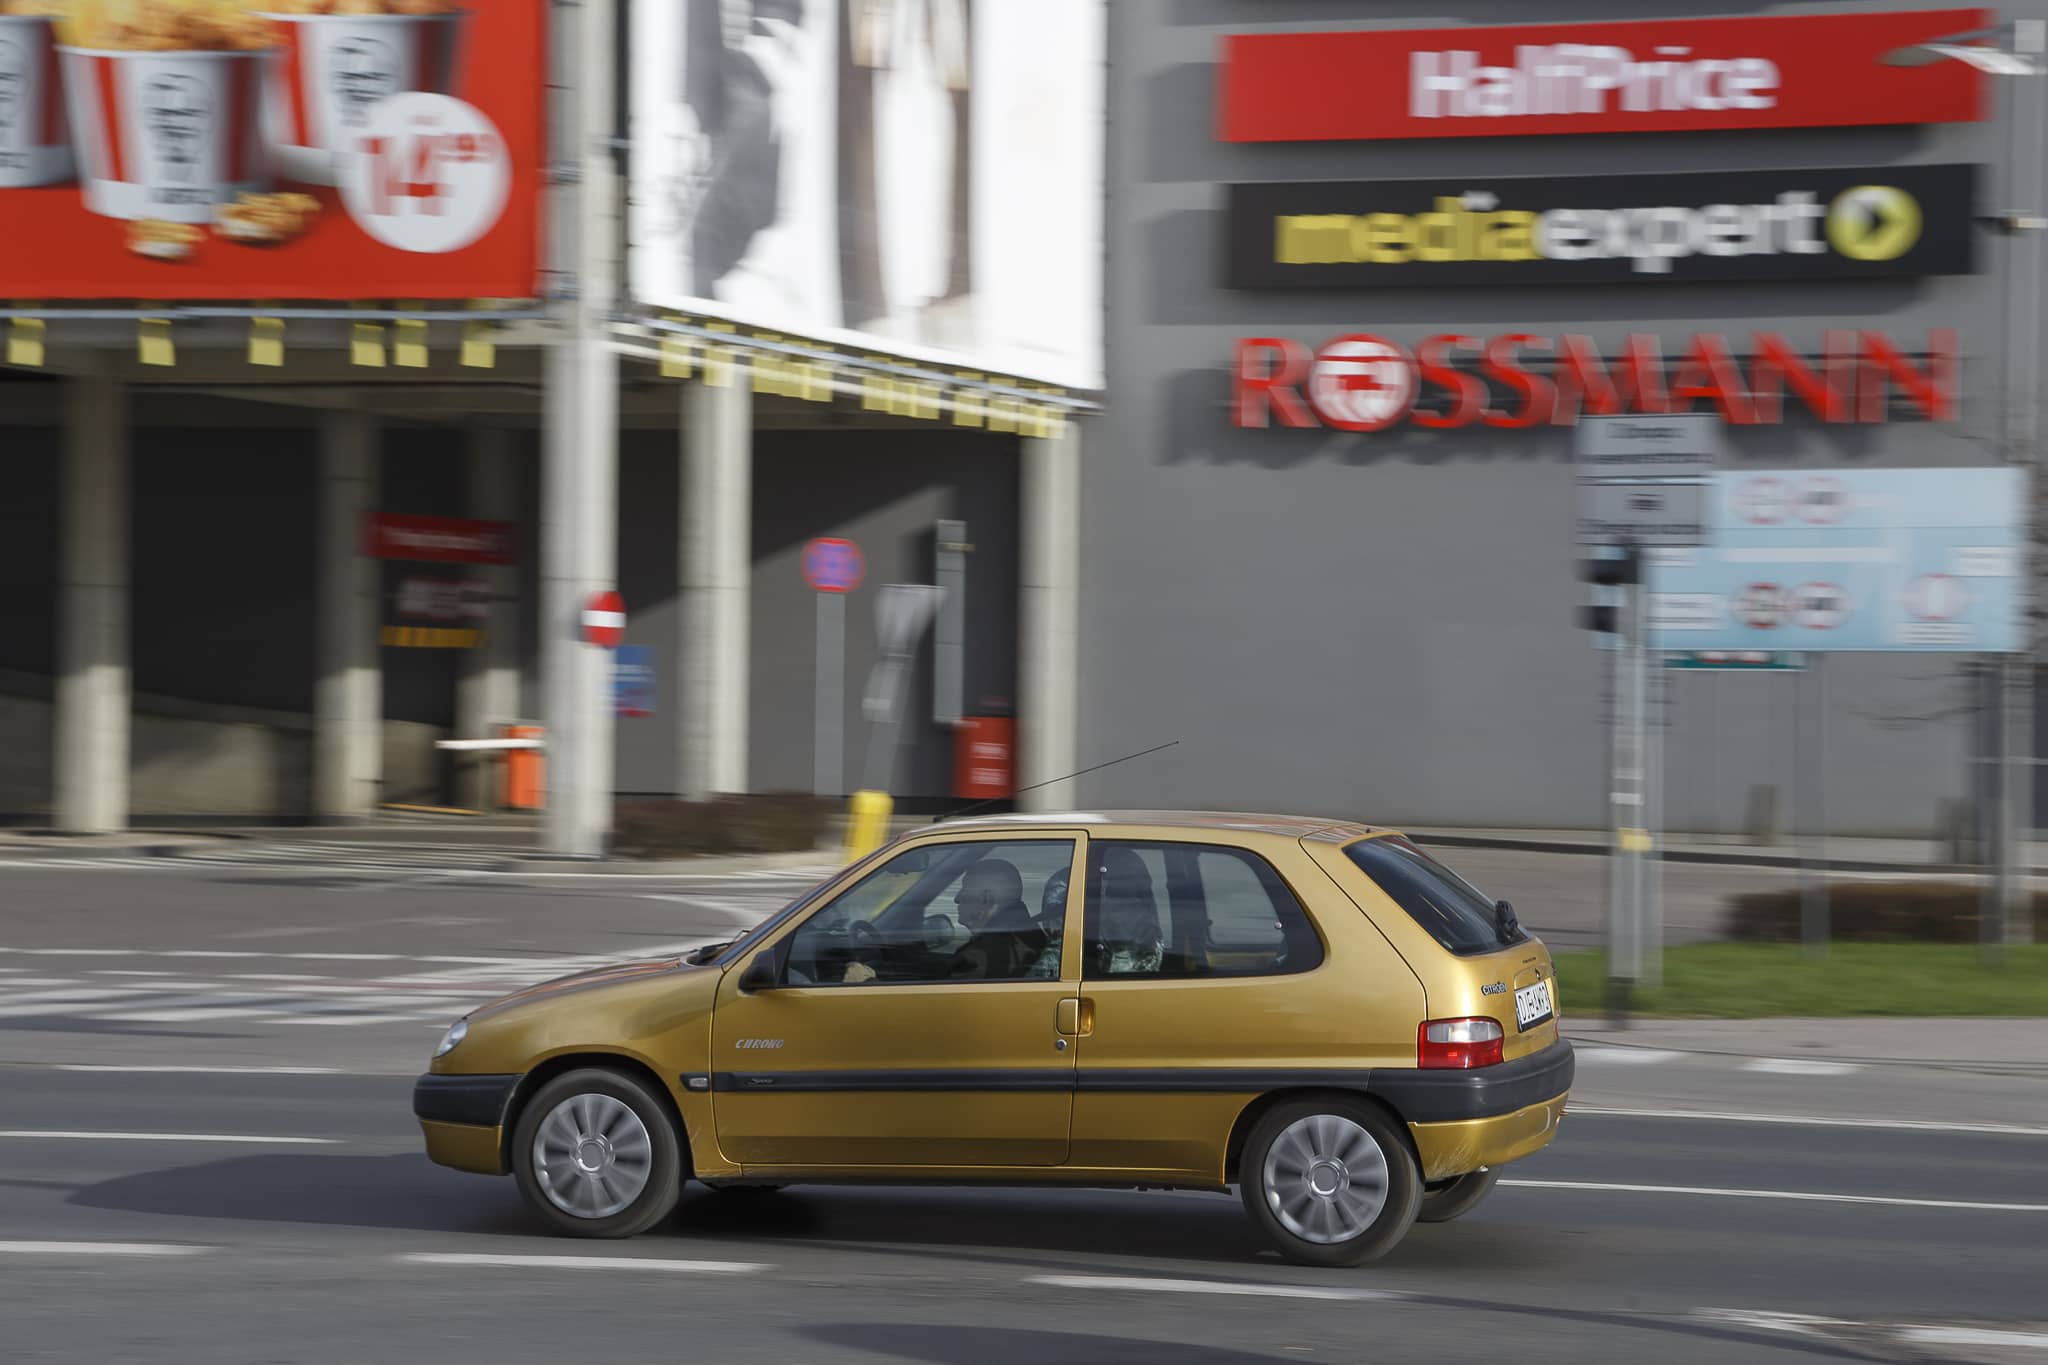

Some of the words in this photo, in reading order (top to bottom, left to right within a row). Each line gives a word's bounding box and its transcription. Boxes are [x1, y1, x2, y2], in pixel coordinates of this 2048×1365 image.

[1409, 43, 1780, 118] HalfPrice
[1233, 328, 1957, 432] ROSSMANN
[735, 1039, 785, 1049] CHRONO
